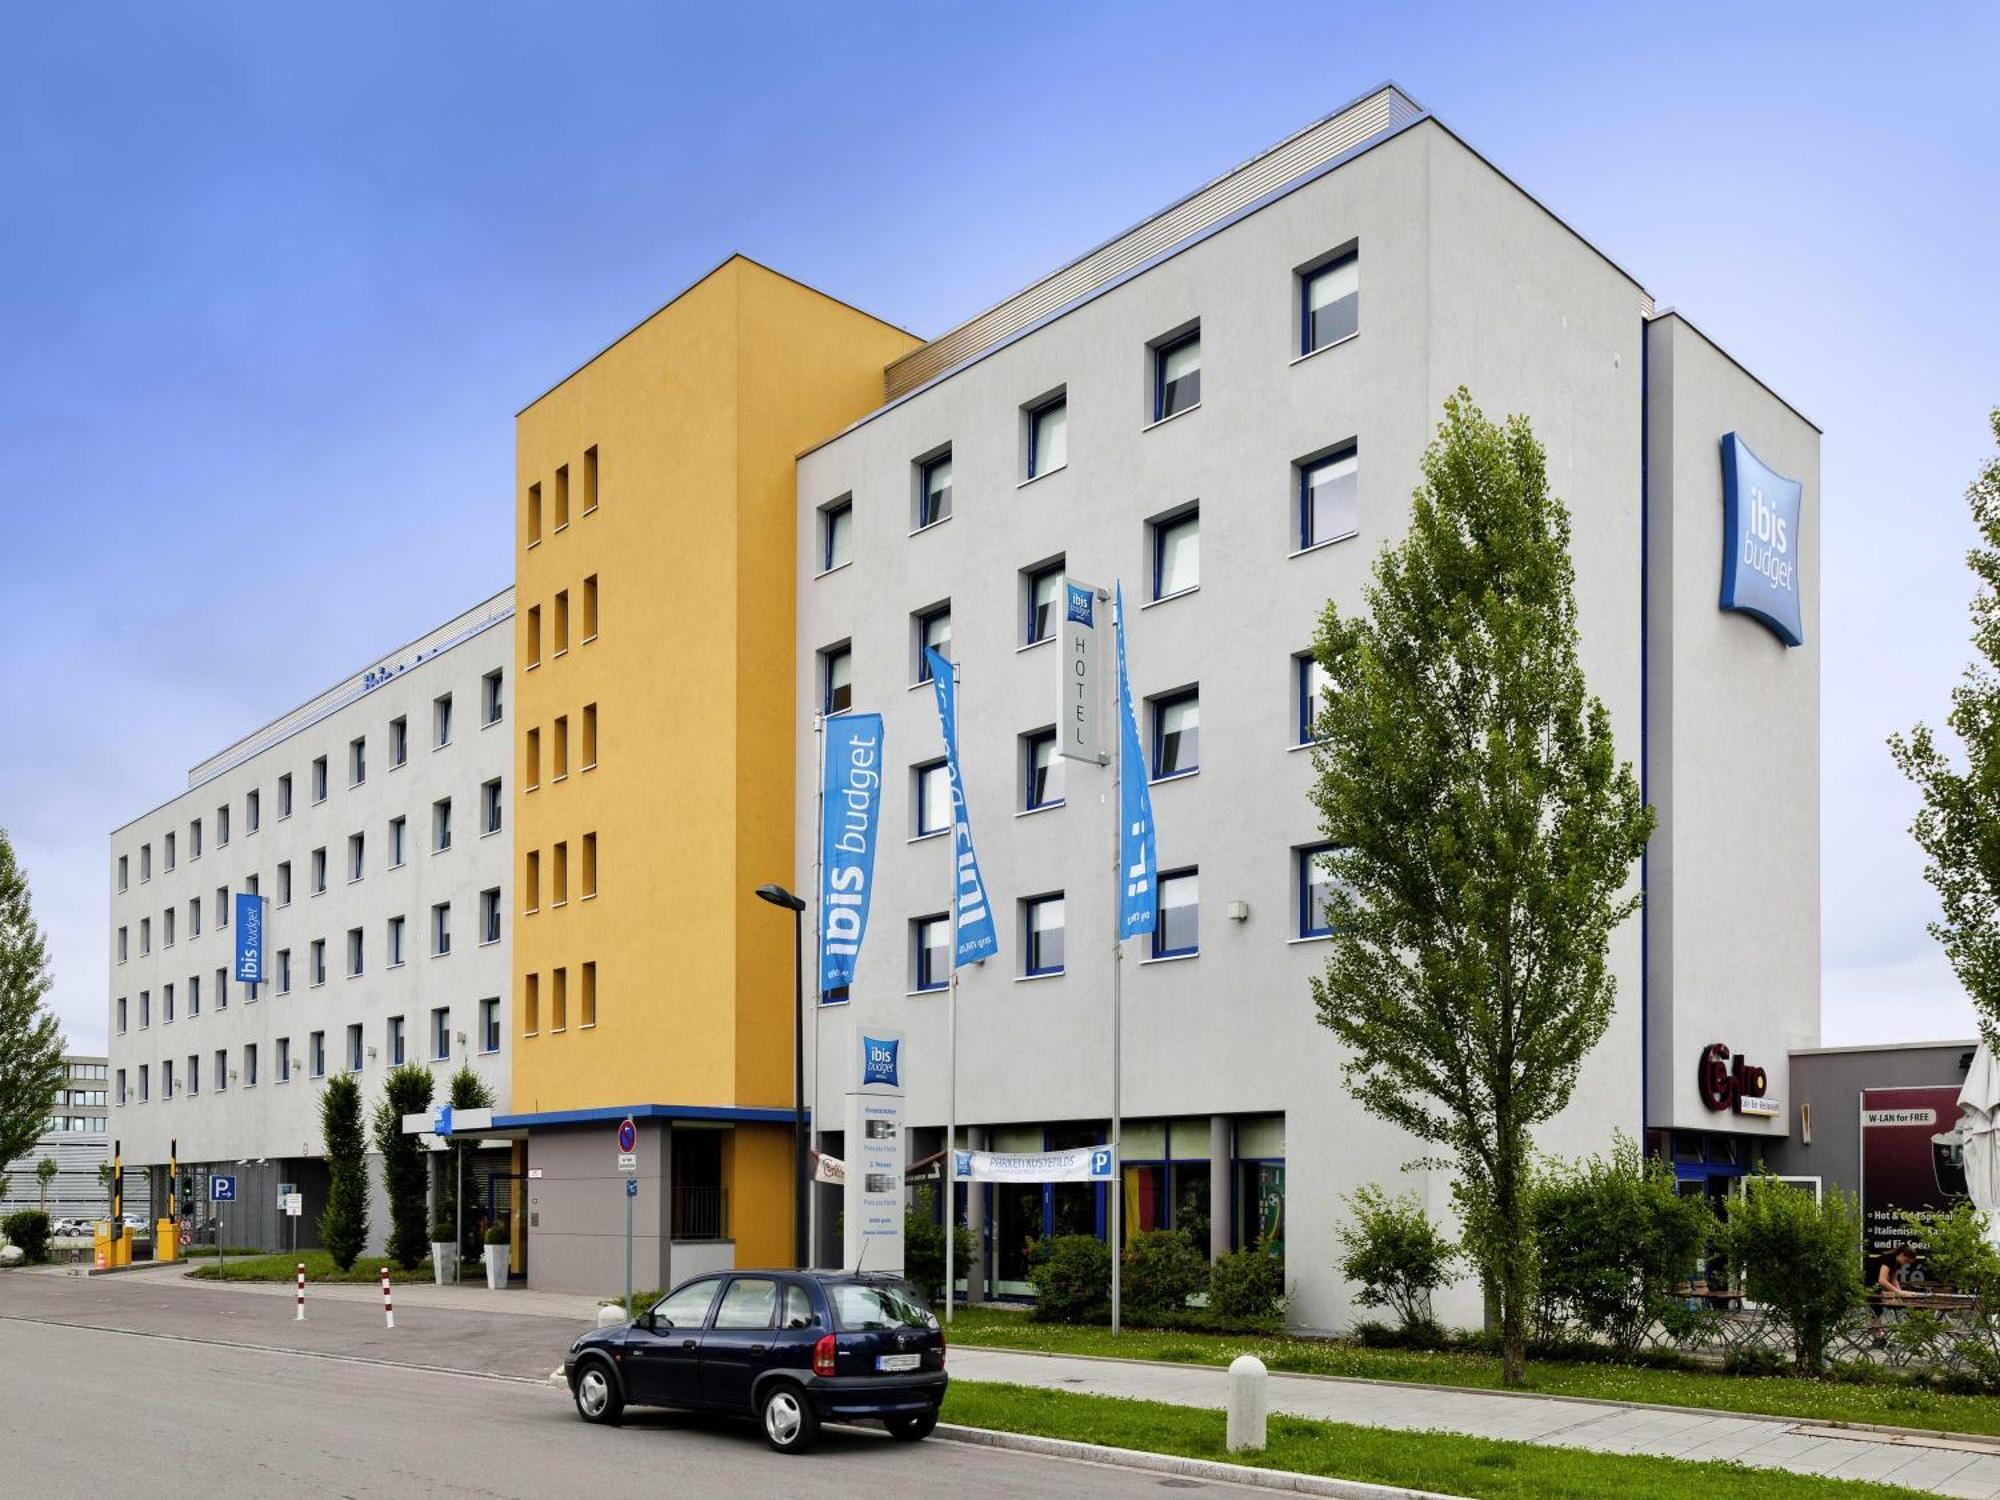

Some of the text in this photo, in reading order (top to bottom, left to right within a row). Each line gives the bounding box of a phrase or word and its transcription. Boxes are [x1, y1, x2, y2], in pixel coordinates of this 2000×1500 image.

[1751, 485, 1788, 554] ibis
[1743, 532, 1793, 591] budget
[1072, 592, 1088, 608] ibis
[1075, 636, 1086, 745] HOTEL
[835, 734, 879, 853] budget
[241, 949, 257, 978] ibis
[871, 1046, 891, 1062] ibis
[1868, 1112, 1929, 1122] W-LAN for FREE
[215, 1178, 229, 1198] P
[1874, 1211, 1890, 1220] Hot
[1874, 1240, 1892, 1249] und
